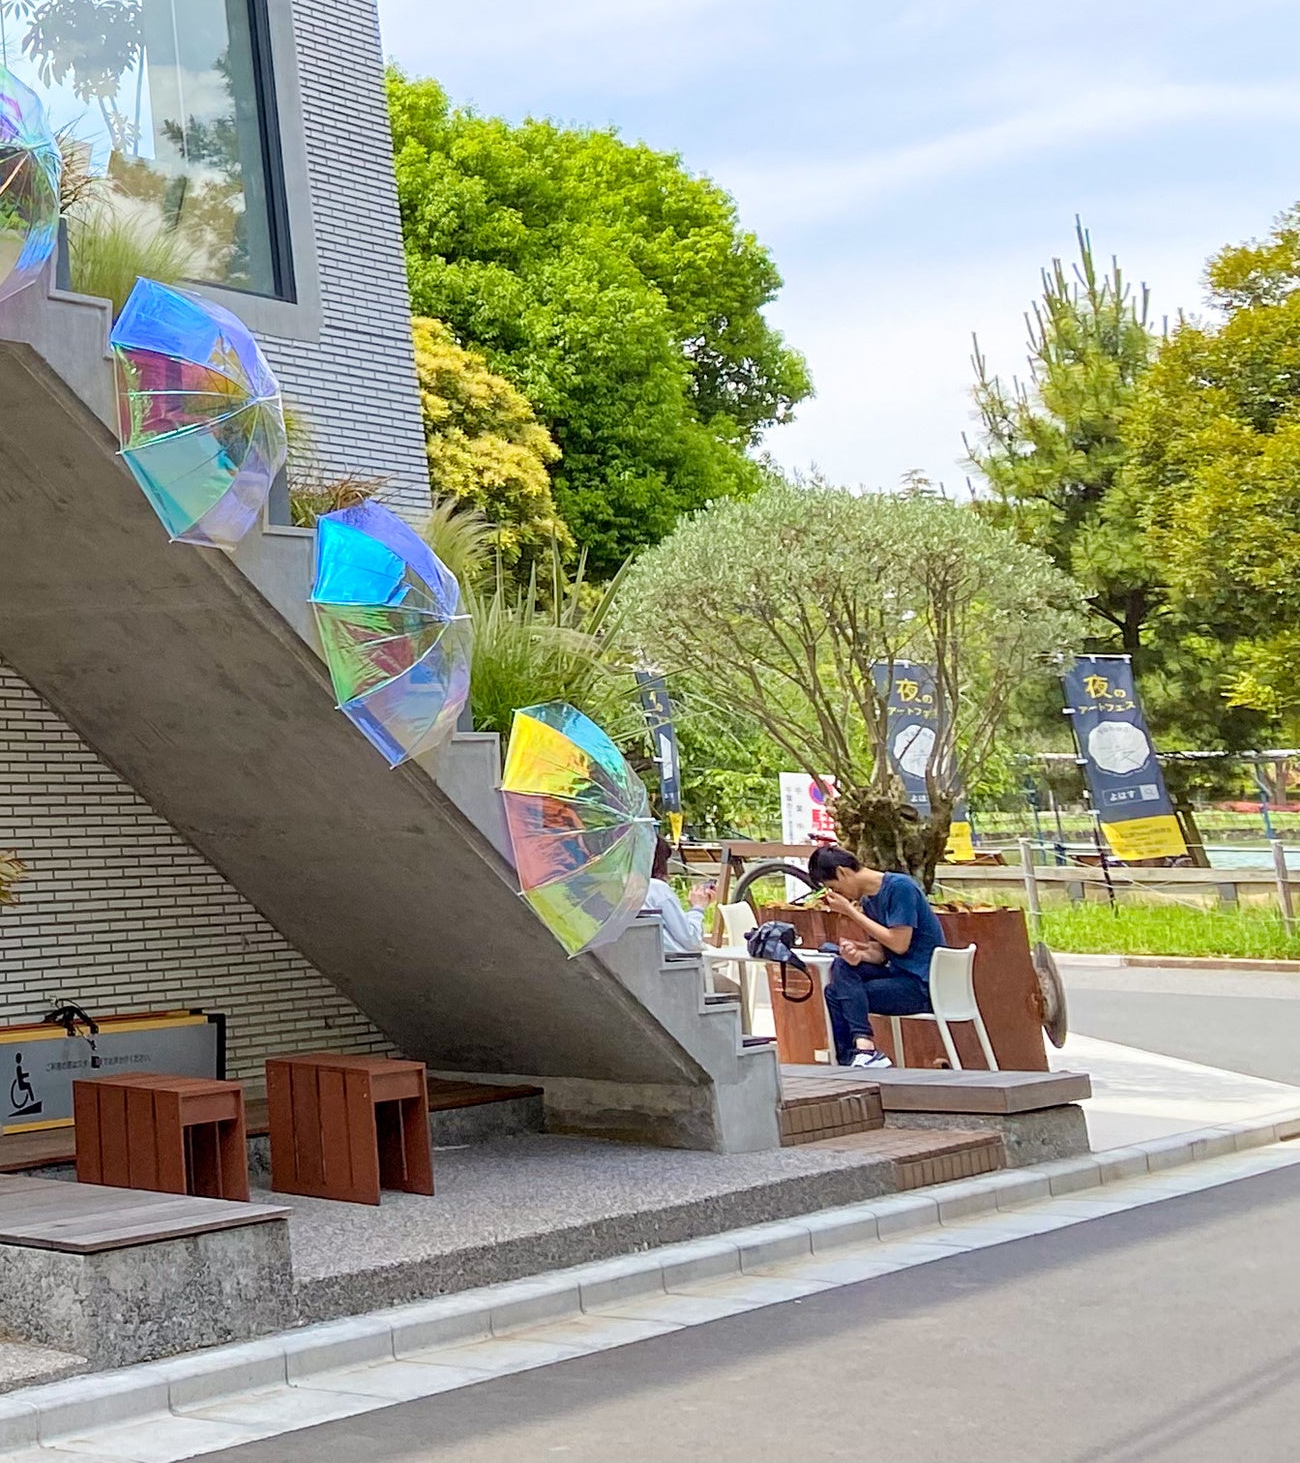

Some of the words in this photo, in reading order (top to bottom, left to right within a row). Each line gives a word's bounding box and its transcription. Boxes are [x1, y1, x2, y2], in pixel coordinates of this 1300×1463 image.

[1083, 673, 1127, 699] 夜の
[1078, 700, 1137, 715] アートフェス
[1109, 790, 1137, 802] よはす
